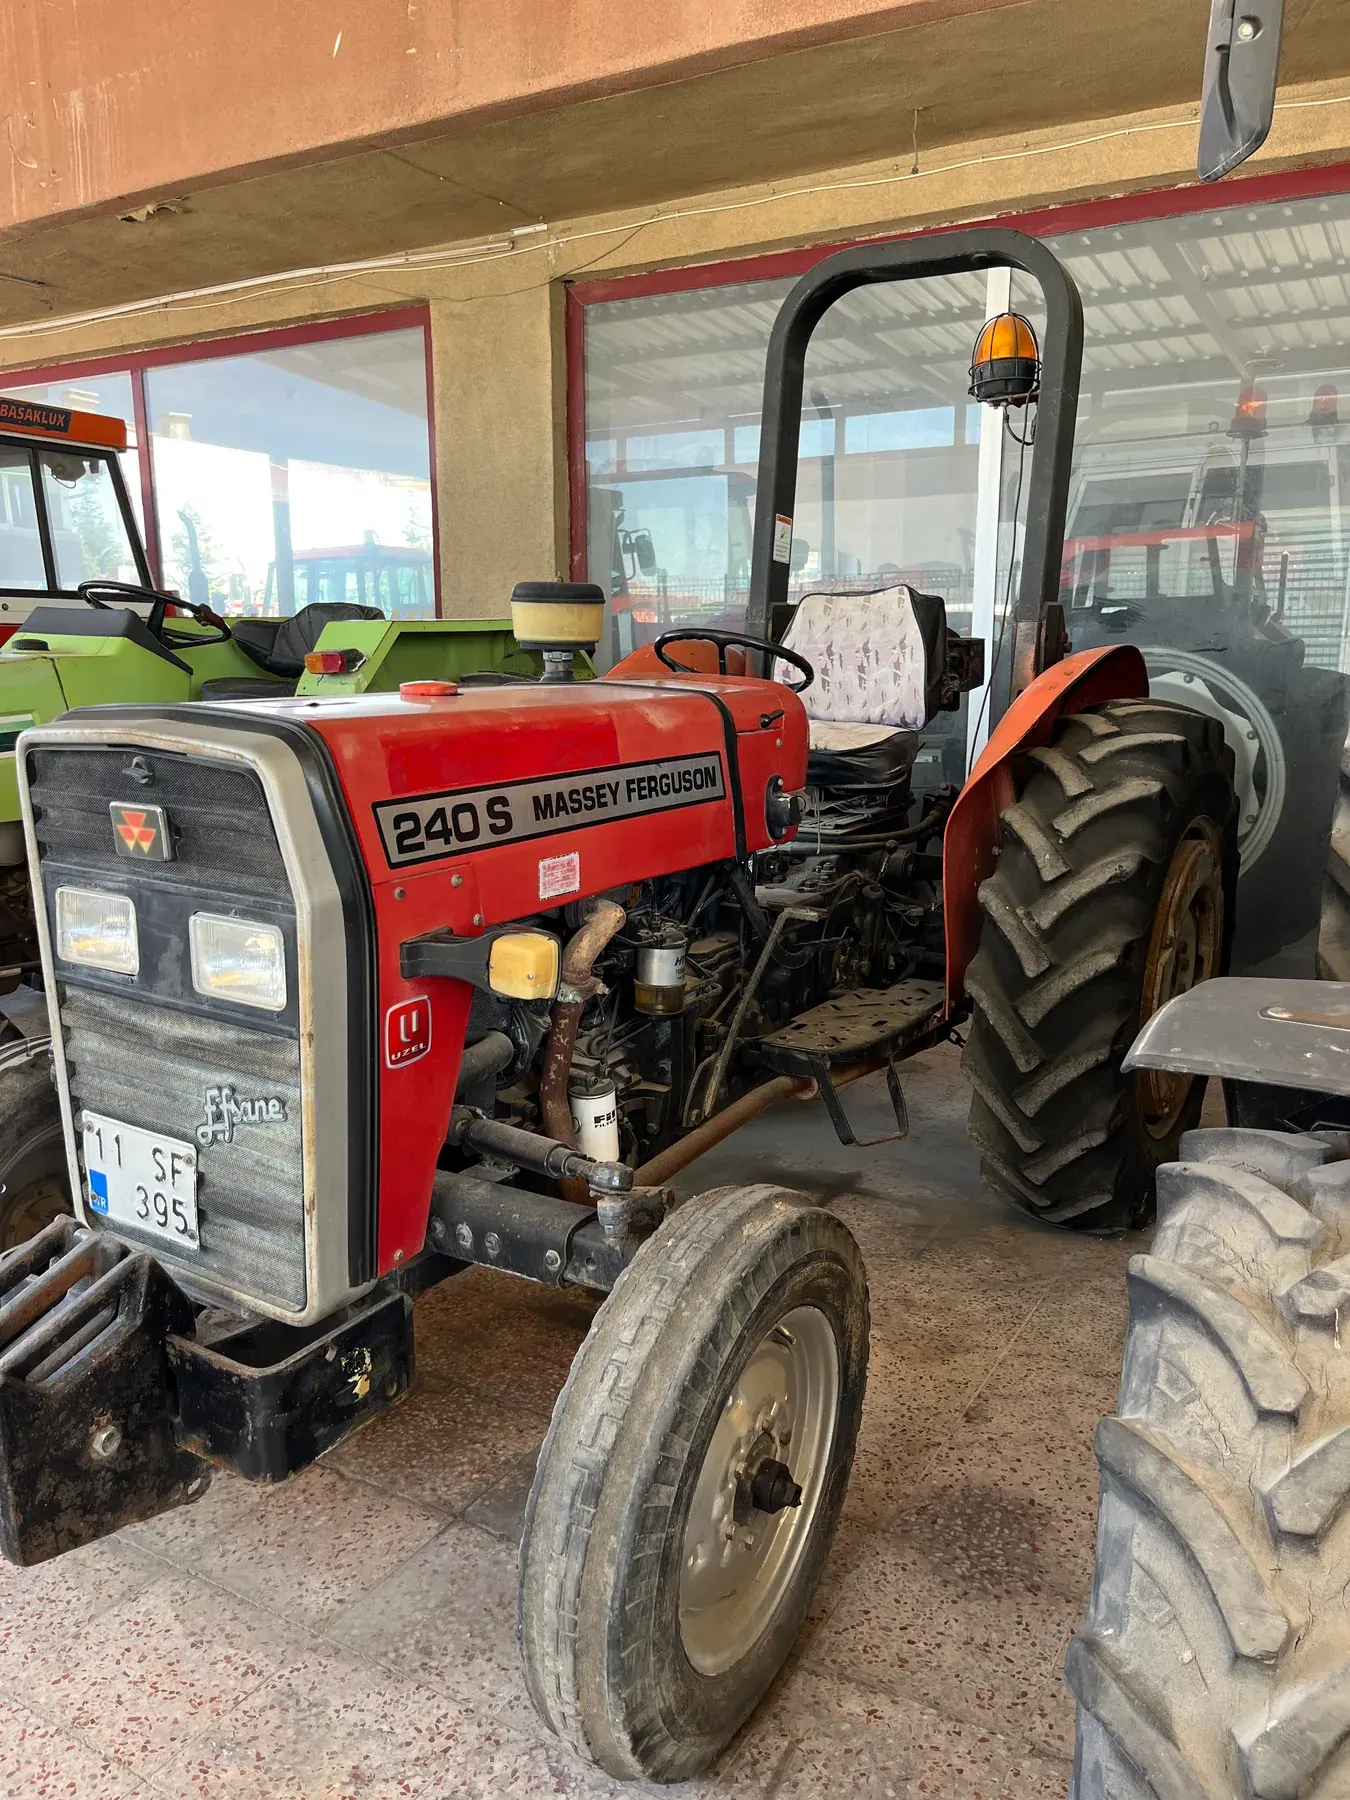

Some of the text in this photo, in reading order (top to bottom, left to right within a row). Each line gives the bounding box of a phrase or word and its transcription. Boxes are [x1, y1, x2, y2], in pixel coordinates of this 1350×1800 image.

[533, 781, 620, 822] MASSEY
[626, 765, 717, 803] FERGUSON
[391, 1042, 427, 1061] UZEL
[95, 1128, 184, 1188] 11 SF
[136, 1185, 189, 1235] 395
